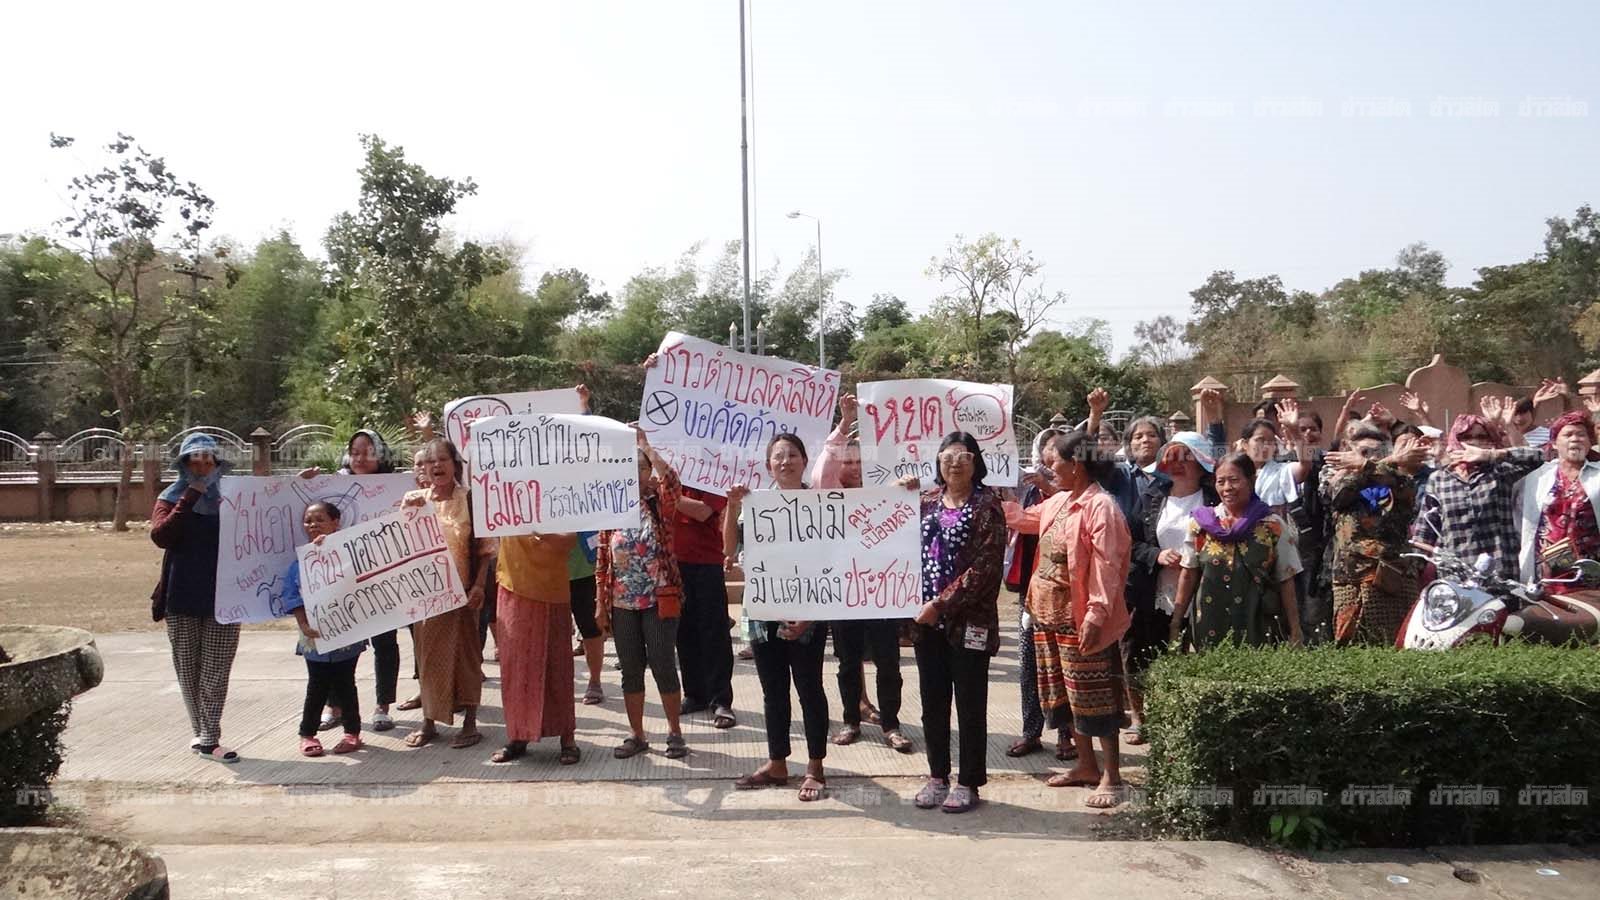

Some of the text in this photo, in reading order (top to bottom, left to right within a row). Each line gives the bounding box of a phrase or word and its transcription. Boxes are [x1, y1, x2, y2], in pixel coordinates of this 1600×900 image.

[865, 396, 944, 461] หยุด
[473, 471, 640, 532] ไม่เอา โรงไฟฟ้าขยะ
[752, 491, 847, 543] เราไม่มี
